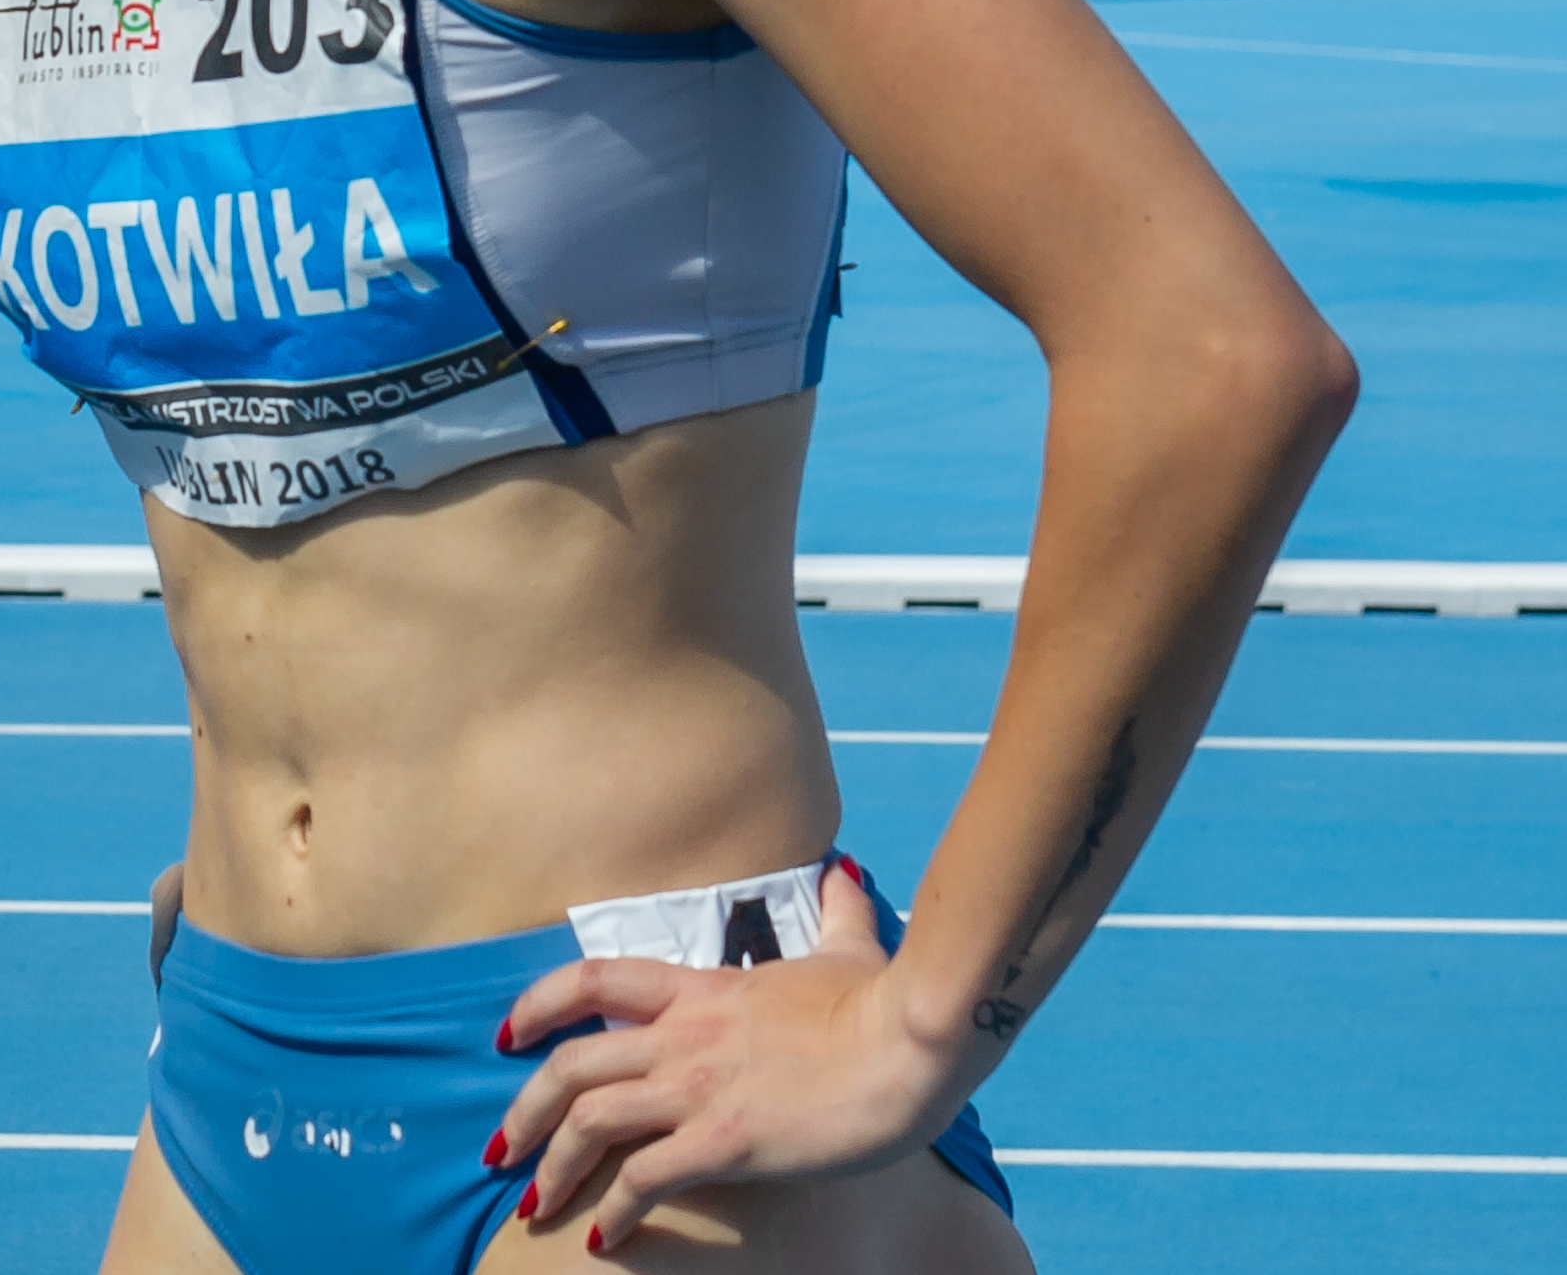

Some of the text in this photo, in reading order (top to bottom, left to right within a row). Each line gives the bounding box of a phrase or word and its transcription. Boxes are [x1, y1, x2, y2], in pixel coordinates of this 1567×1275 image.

[346, 356, 488, 416] POLSKI
[155, 445, 396, 507] LUBLIN 2018
